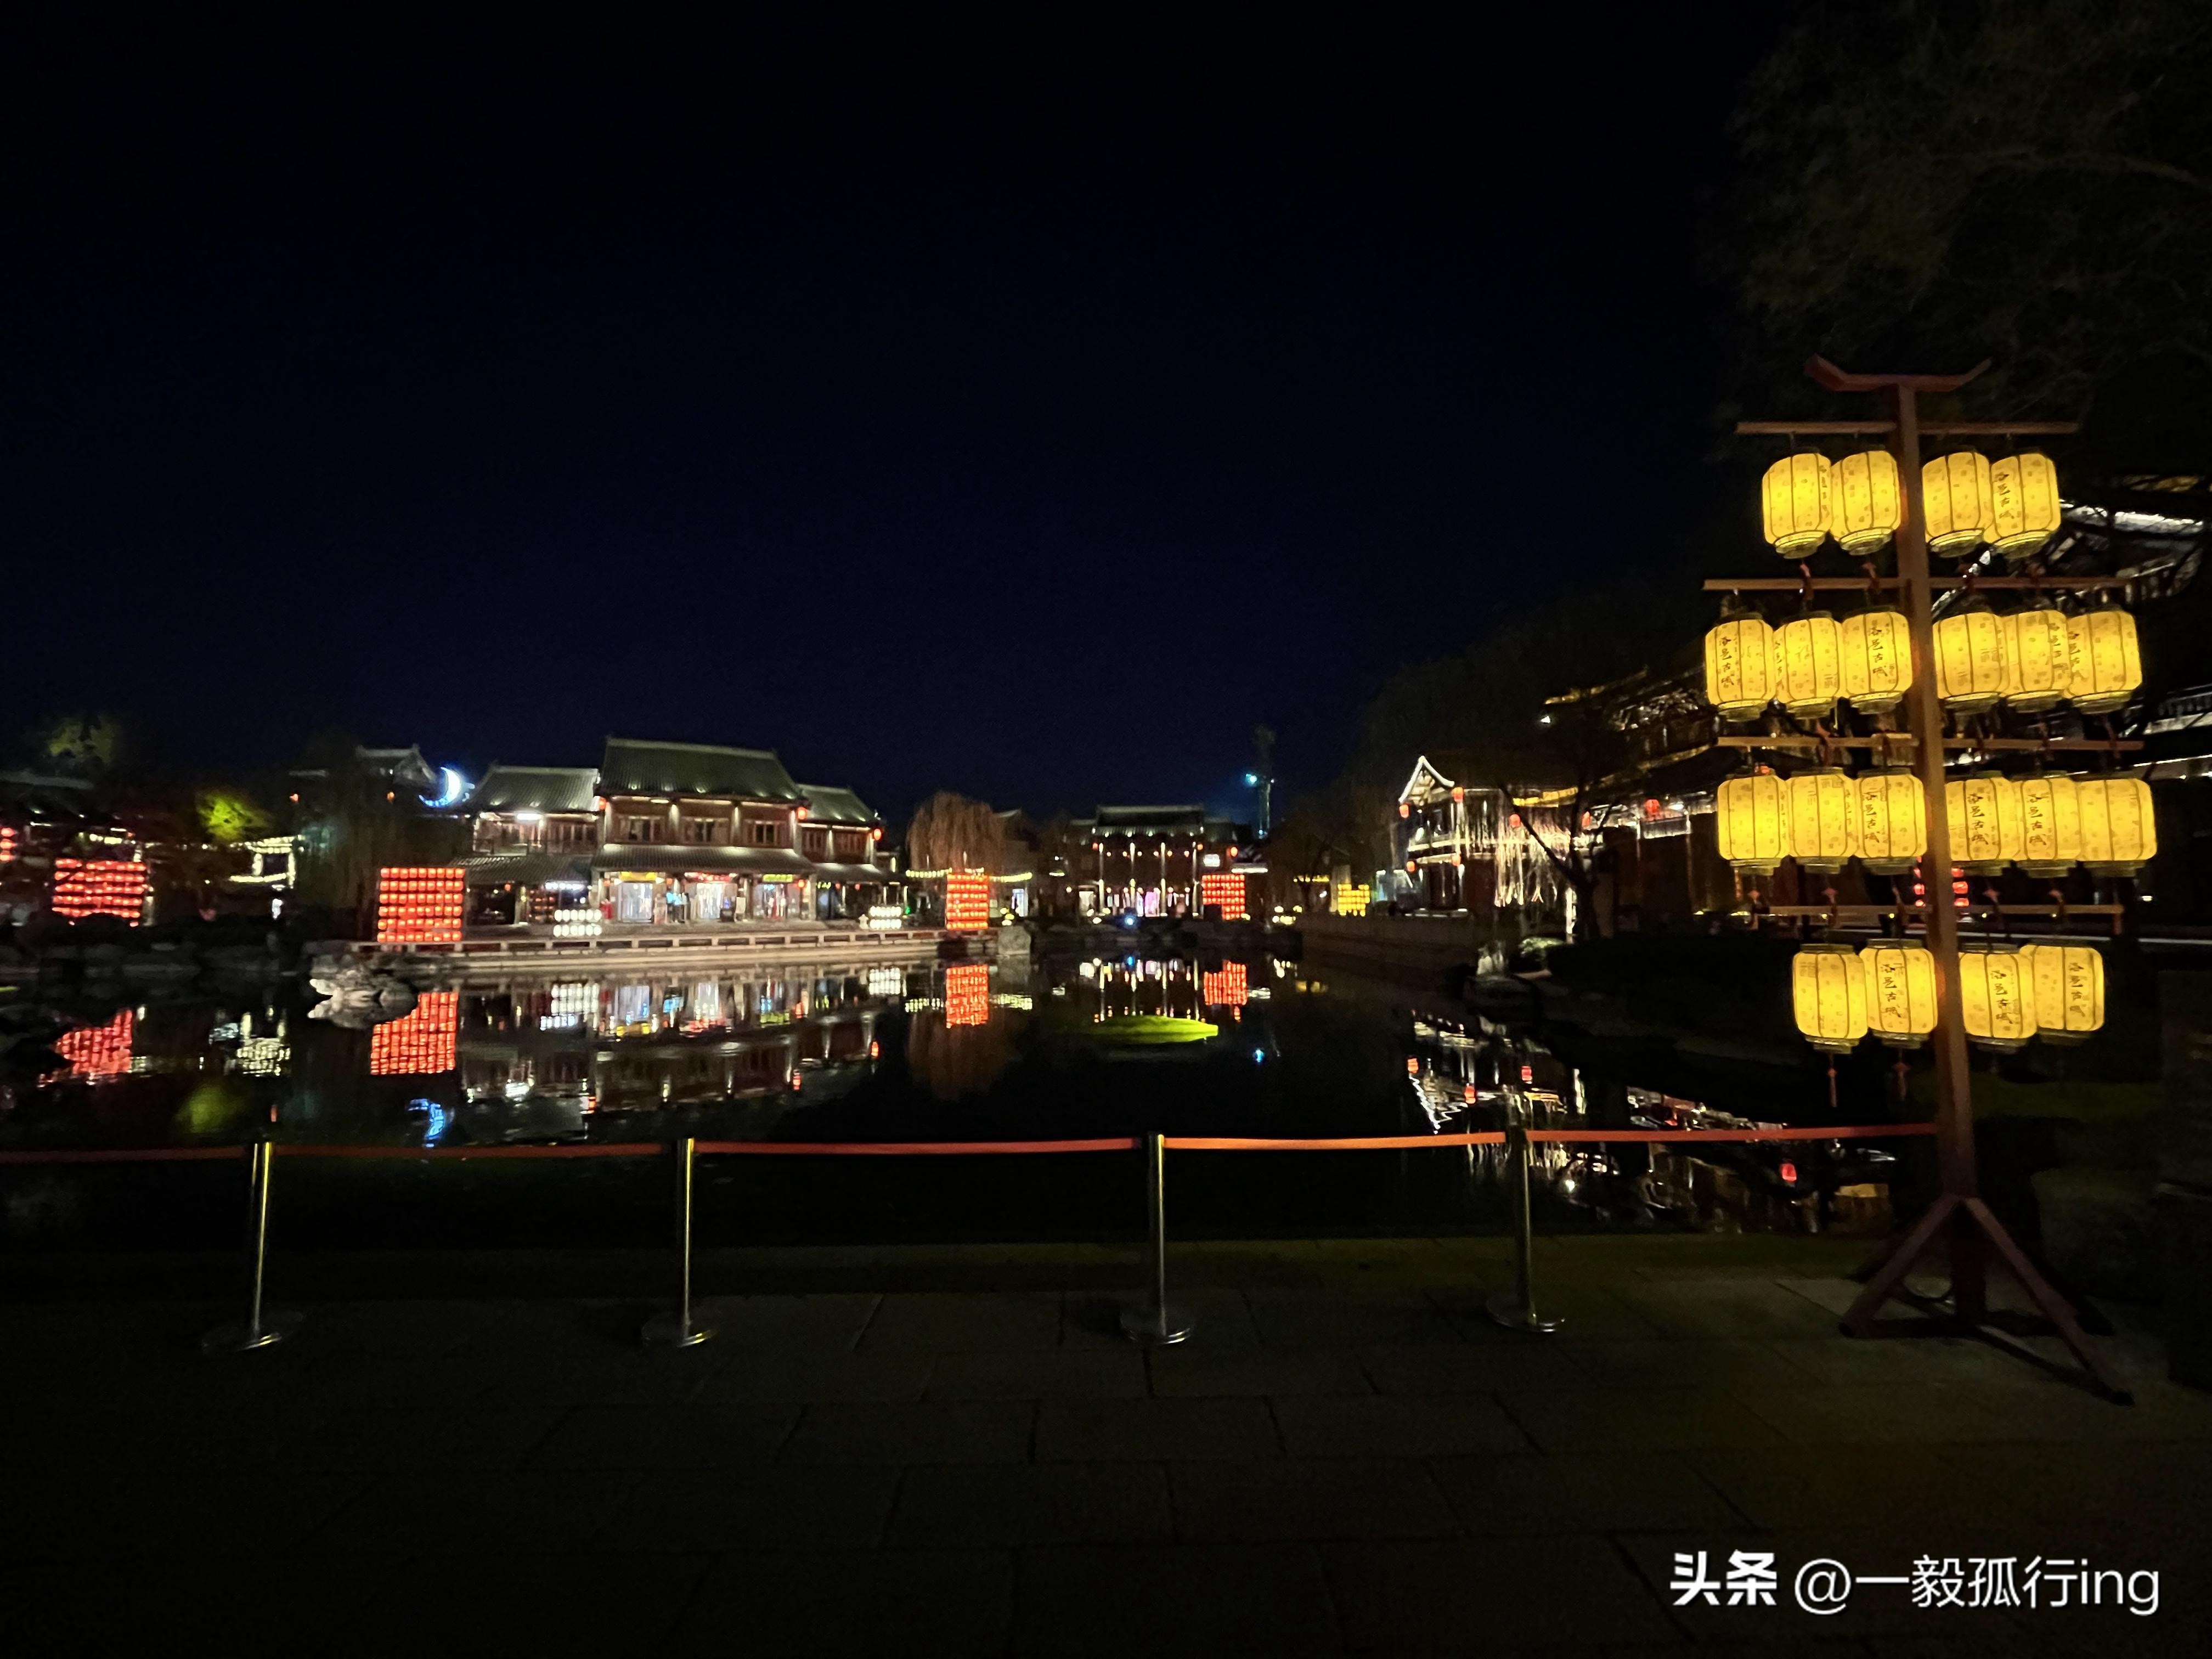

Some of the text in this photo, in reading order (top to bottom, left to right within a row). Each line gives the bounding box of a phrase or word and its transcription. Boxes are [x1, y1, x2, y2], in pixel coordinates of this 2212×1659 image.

[1869, 627, 1888, 677] 洛邑古城
[1863, 791, 1880, 843] 洛邑古城
[1967, 793, 1989, 845] 洛邑古城
[2027, 794, 2047, 845] 洛邑古城
[1880, 963, 1901, 1018] 洛邑古城
[1991, 969, 2013, 1024] 洛邑古城
[2069, 962, 2085, 1017] 洛邑古城
